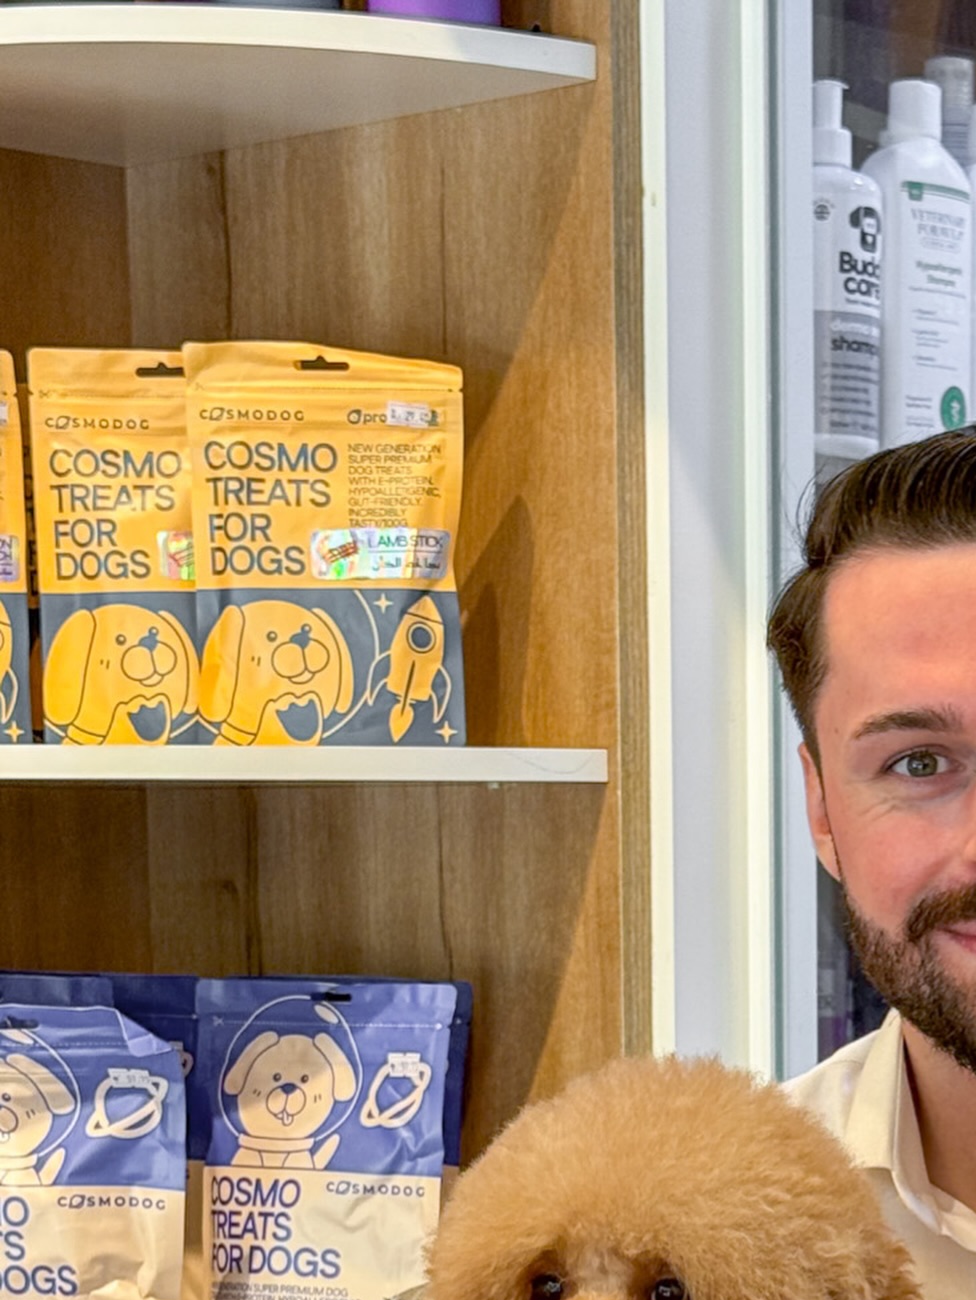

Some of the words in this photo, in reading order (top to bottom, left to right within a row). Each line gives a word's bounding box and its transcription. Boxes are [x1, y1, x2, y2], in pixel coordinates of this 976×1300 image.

[49, 449, 182, 479] COSMO
[204, 440, 338, 473] COSMO
[348, 466, 373, 476] DOG
[50, 484, 175, 513] TREATS
[206, 477, 331, 507] TREATS
[54, 519, 117, 548] FOR
[209, 513, 272, 542] FOR
[56, 550, 151, 581] DOGS
[211, 545, 306, 576] DOGS
[211, 1176, 302, 1208] COSMO
[211, 1209, 292, 1242] TREATS
[248, 1246, 341, 1279] DOGS
[325, 1287, 349, 1298] DOG
